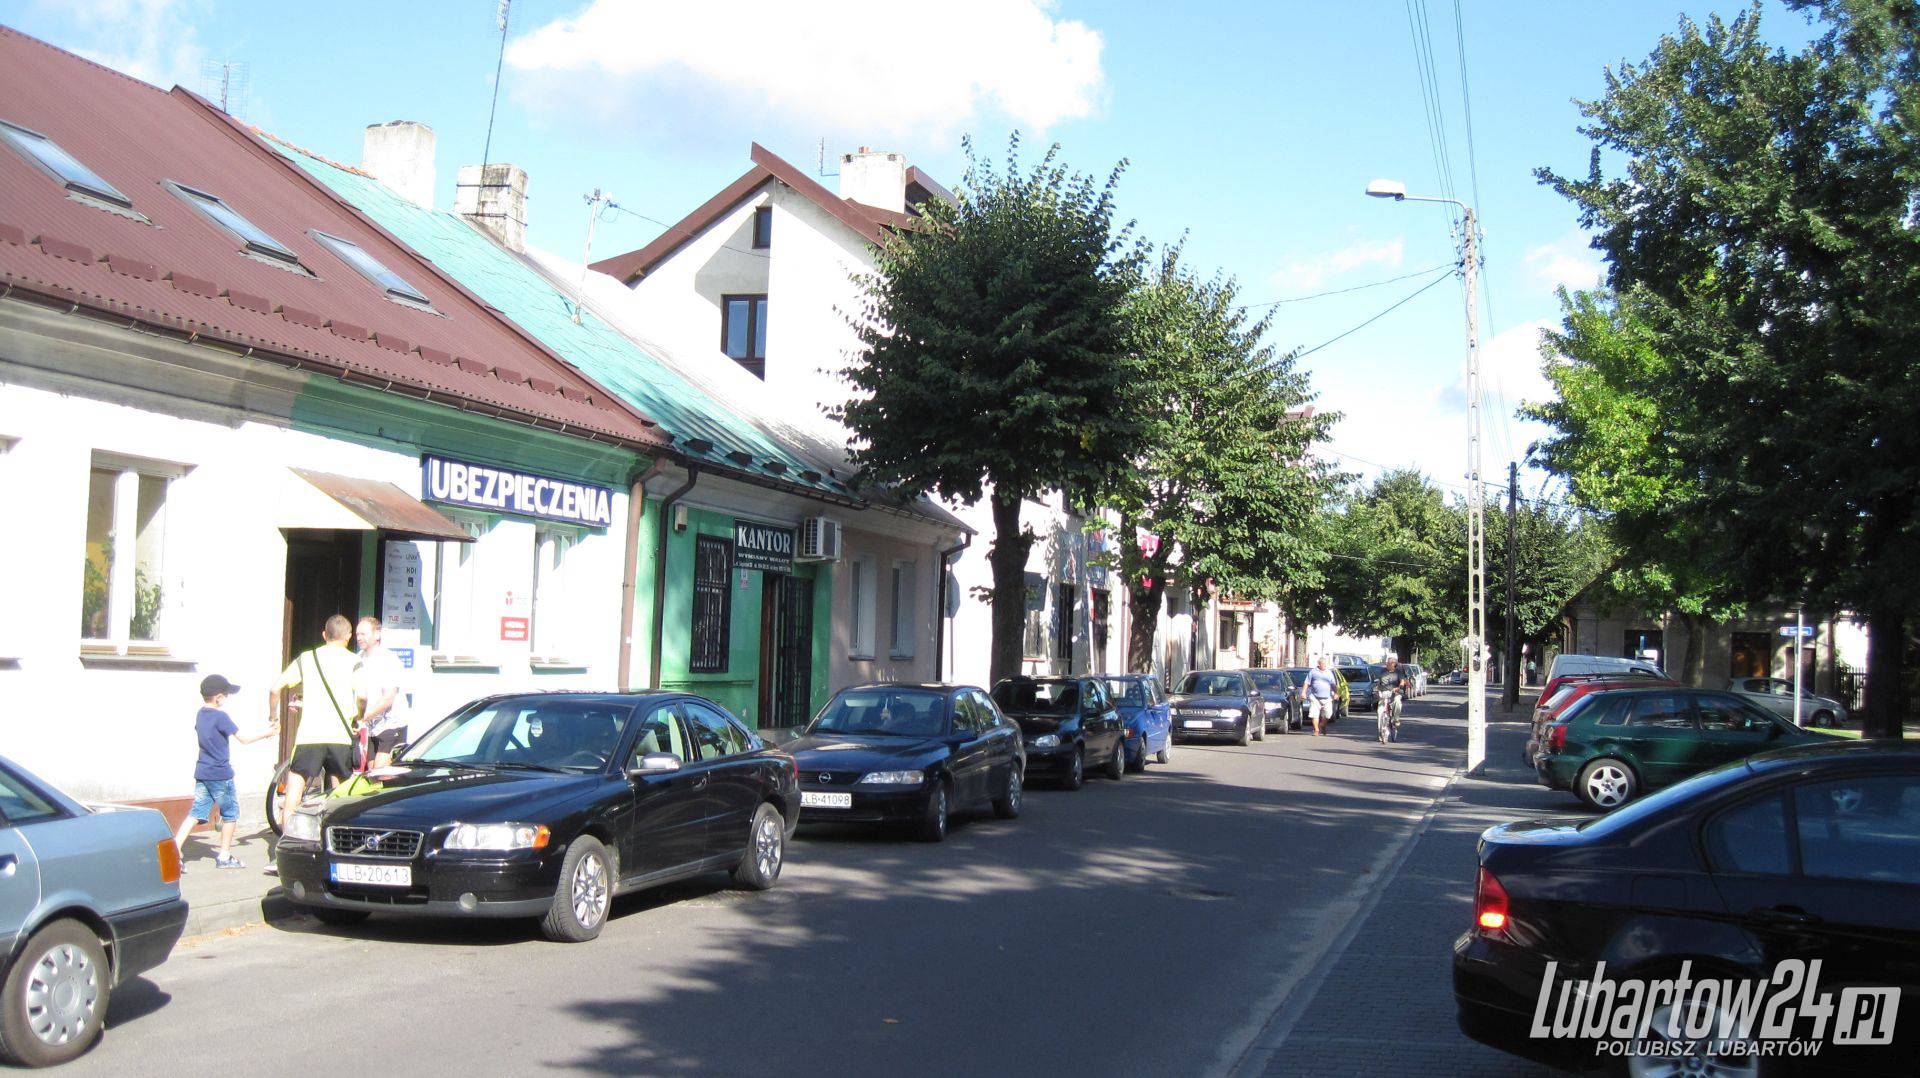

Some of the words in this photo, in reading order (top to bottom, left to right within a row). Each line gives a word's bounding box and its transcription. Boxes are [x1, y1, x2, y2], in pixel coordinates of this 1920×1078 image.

[431, 459, 611, 524] UBEZPIECZENIA
[737, 525, 791, 554] KANTOR
[820, 794, 850, 806] 41098
[368, 866, 409, 884] 20613
